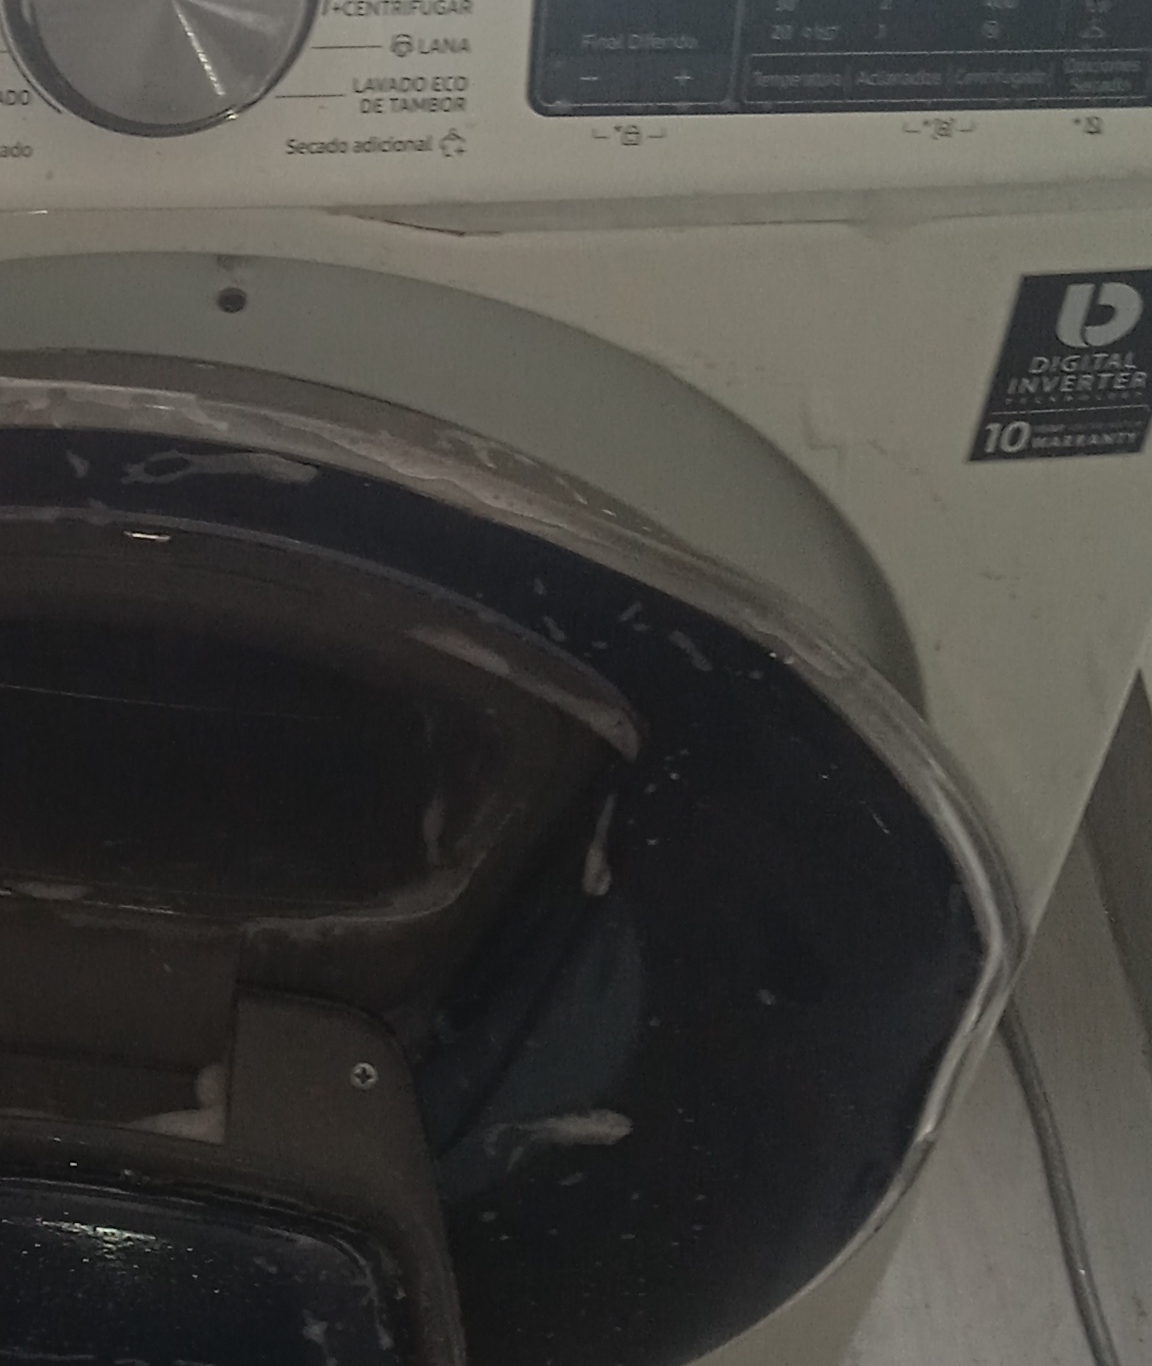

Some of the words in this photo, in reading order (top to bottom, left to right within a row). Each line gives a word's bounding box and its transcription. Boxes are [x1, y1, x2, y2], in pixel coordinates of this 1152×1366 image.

[417, 38, 472, 55] LANA
[352, 76, 429, 94] LAVADO
[431, 75, 470, 92] ECO
[359, 97, 384, 114] DE
[388, 96, 467, 113] TAMBOR
[285, 138, 347, 155] Secado
[352, 136, 433, 154] adicional
[1029, 353, 1137, 374] DIGITAL
[1007, 371, 1148, 394] INVERTER
[984, 420, 1032, 453] 10
